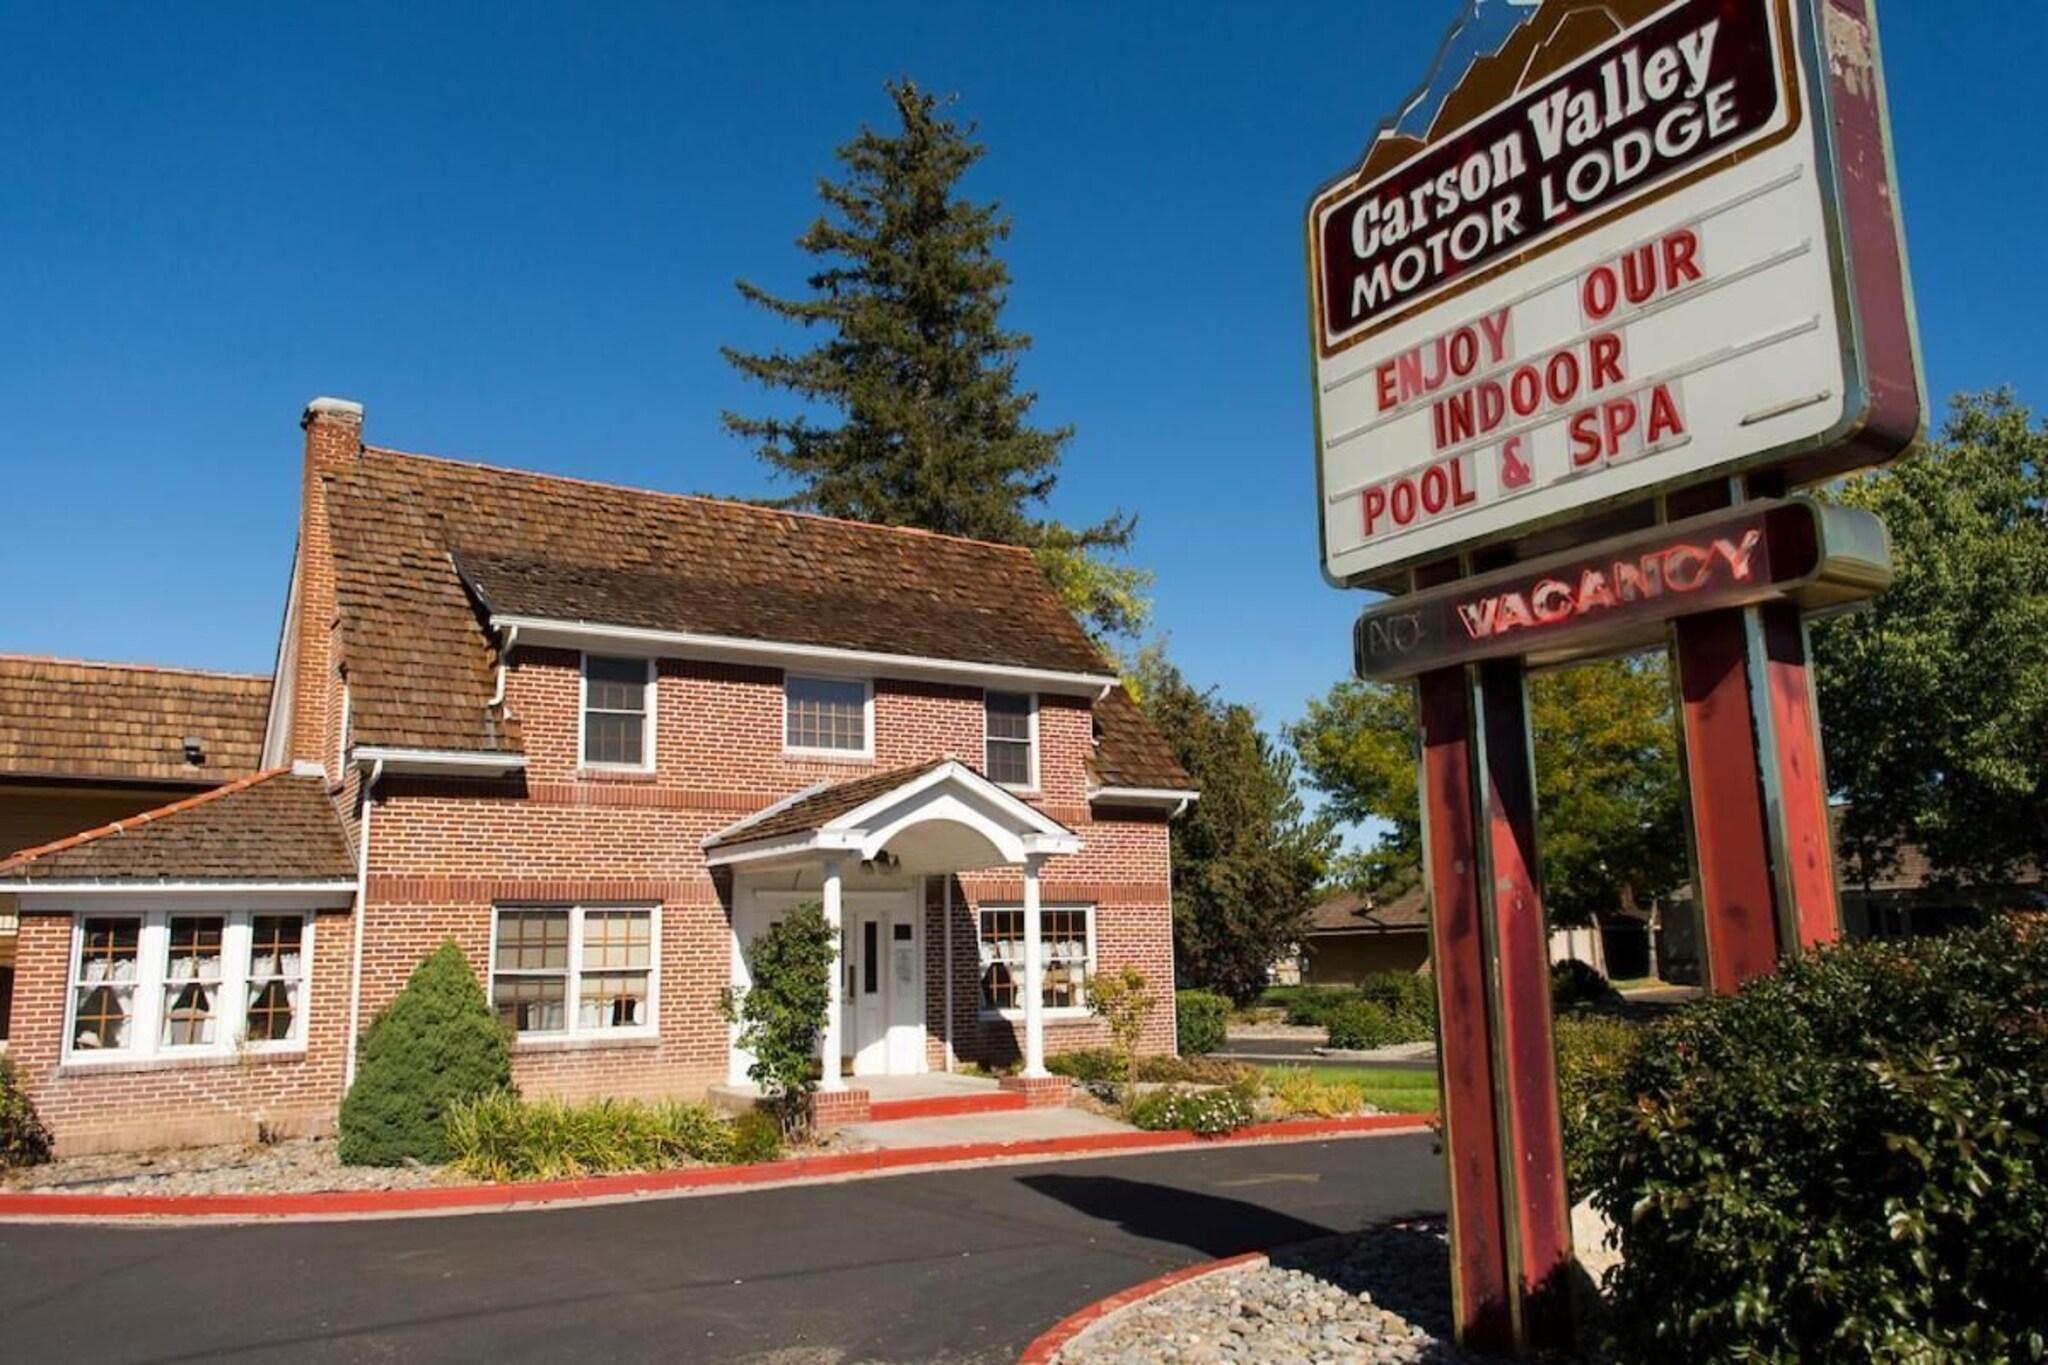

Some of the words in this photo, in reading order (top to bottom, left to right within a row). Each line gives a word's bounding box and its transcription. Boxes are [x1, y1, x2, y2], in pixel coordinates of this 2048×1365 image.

[1350, 194, 1525, 318] MOTOR
[1541, 80, 1740, 222] LODGE
[1351, 130, 1527, 260] Carson
[1527, 20, 1722, 160] Valley
[1376, 306, 1514, 411] ENJOY
[1582, 228, 1702, 320] OUR
[1433, 331, 1626, 449] INDOOR
[1363, 459, 1475, 536] POOL
[1501, 436, 1531, 488] &
[1569, 382, 1684, 467] SPA
[1458, 530, 1760, 639] VACANCY
